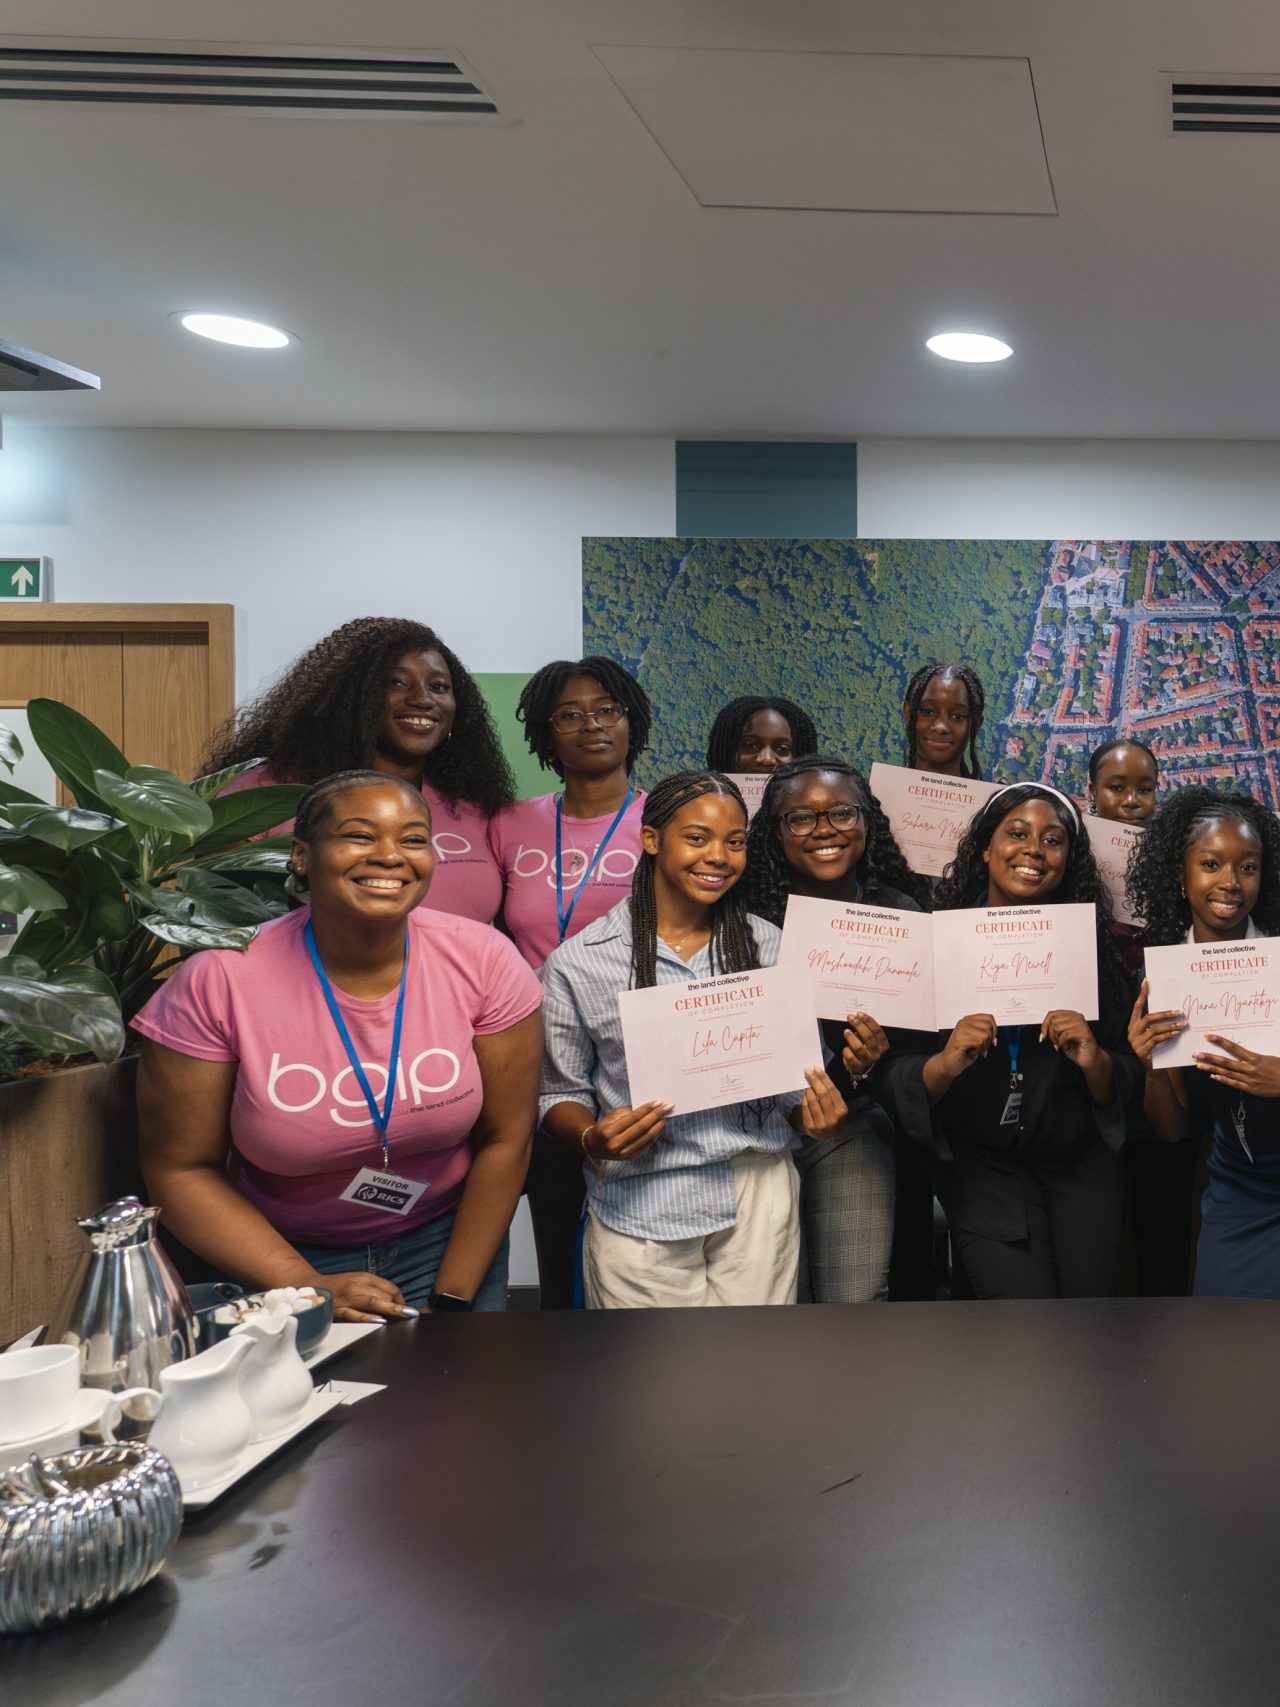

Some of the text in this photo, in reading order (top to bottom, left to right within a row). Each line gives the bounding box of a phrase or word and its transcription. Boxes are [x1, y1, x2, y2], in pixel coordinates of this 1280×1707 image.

[930, 777, 942, 785] land
[943, 779, 968, 789] collective
[908, 784, 976, 804] CERTIFICATE
[845, 908, 900, 922] the land collective
[1012, 908, 1041, 916] collective
[830, 919, 910, 939] CERTIFICATE
[975, 920, 1053, 934] CERTIFICATE
[1212, 947, 1226, 955] land
[1227, 945, 1256, 954] collective
[807, 949, 921, 983] Moshoodah Danmola
[1011, 952, 1053, 978] Newell
[1190, 956, 1269, 973] CERTIFICATE
[687, 975, 750, 991] the land collective
[674, 985, 765, 1012] CERTIFICATE
[1182, 994, 1217, 1020] Nana
[267, 1048, 460, 1127] bgip
[372, 1175, 409, 1191] VISITOR
[376, 1192, 406, 1205] RICS
